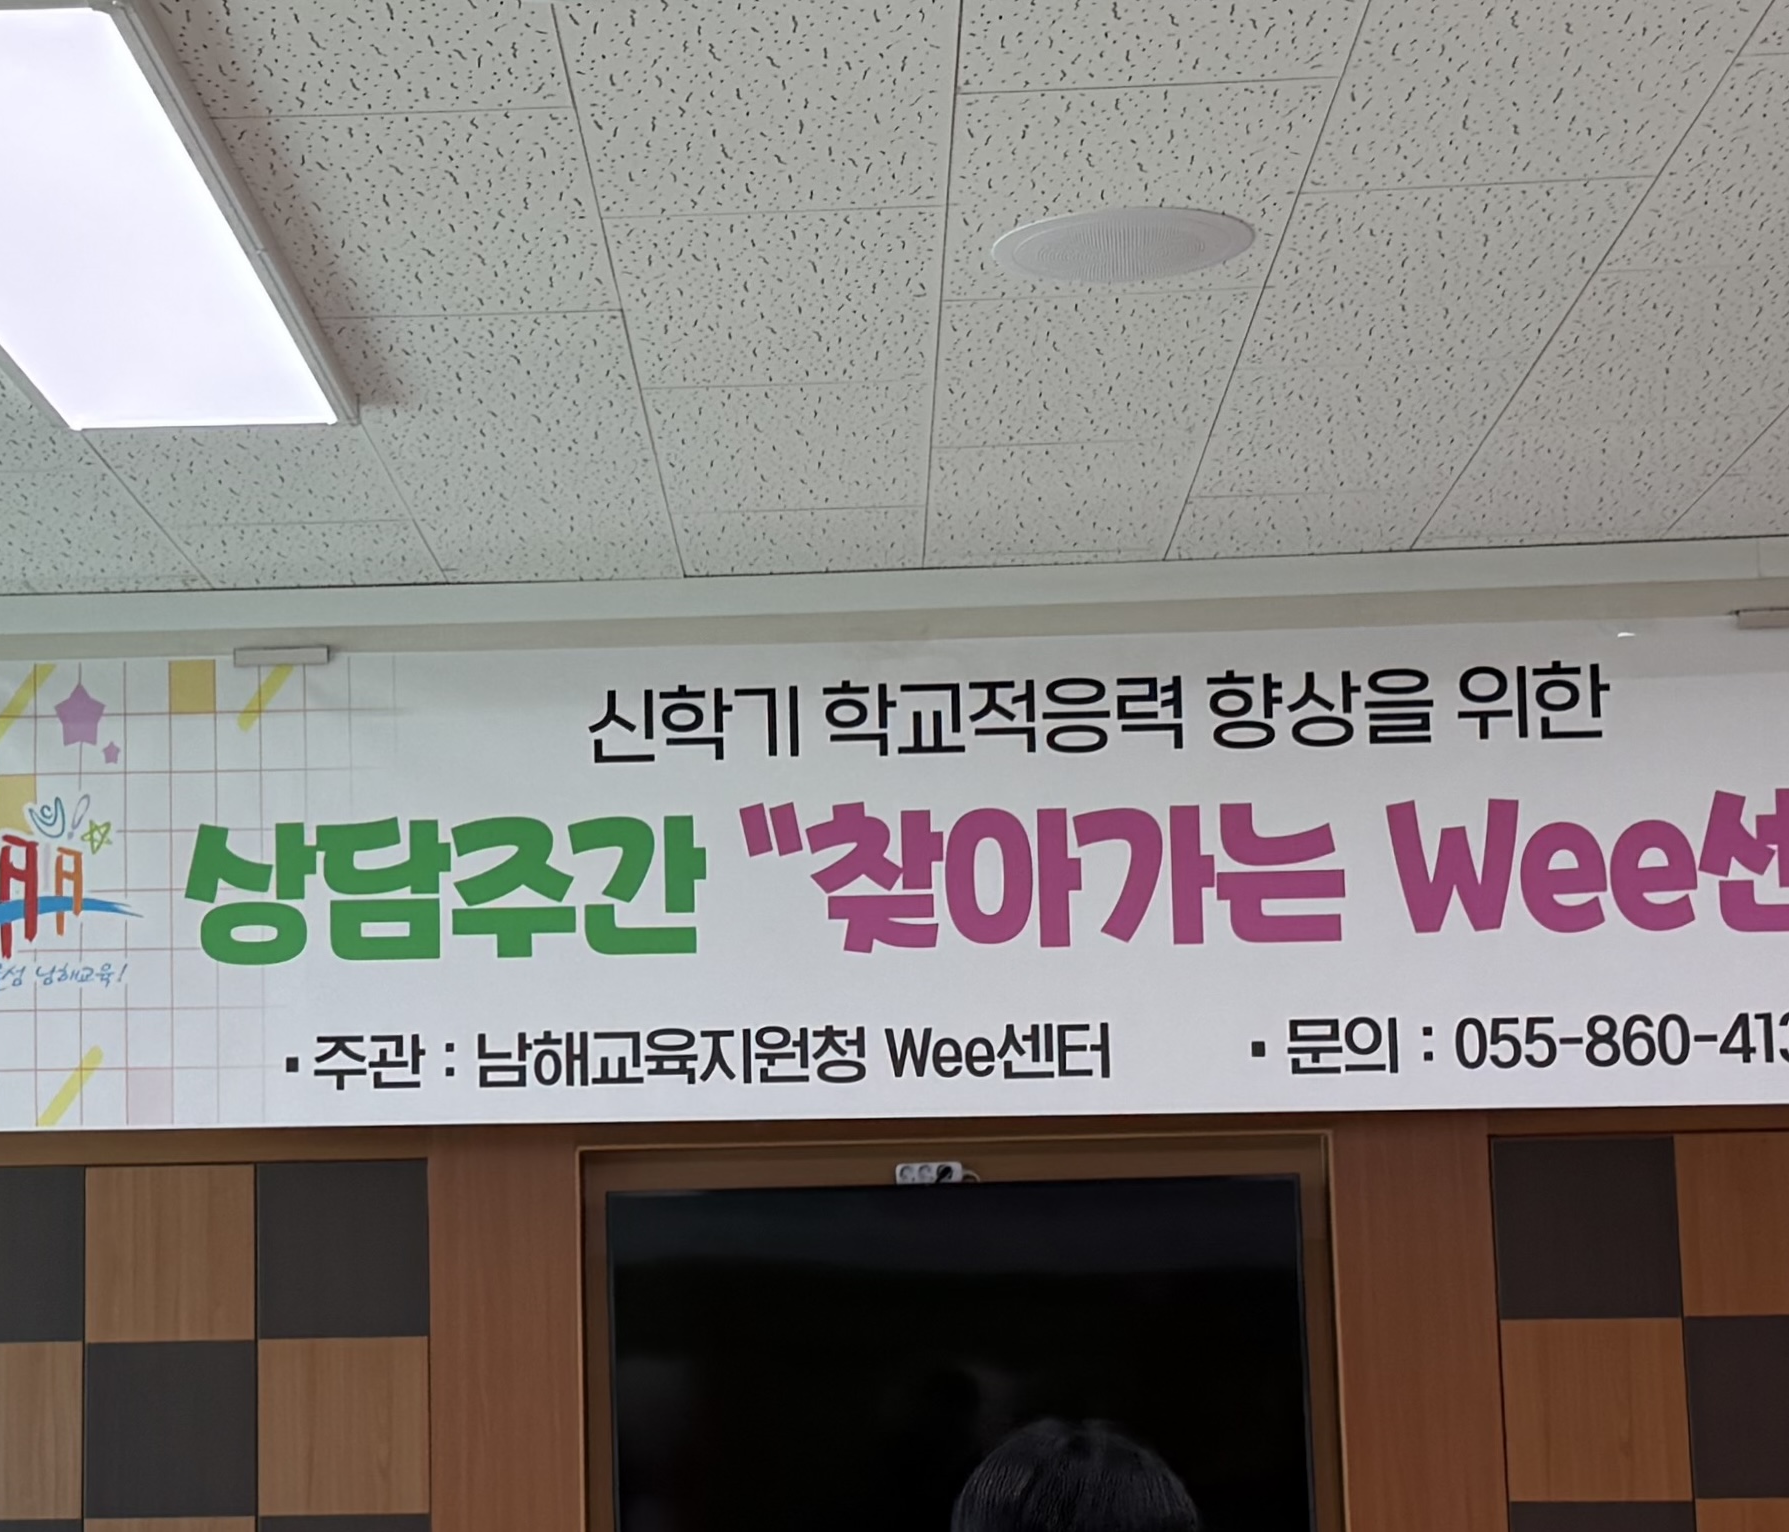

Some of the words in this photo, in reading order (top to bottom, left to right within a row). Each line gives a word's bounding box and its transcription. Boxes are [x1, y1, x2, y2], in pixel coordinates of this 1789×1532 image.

[589, 684, 801, 765] 신학기
[823, 674, 1186, 758] 학교적응력
[1206, 667, 1435, 751] 향상을
[1457, 659, 1612, 743] 위한
[185, 818, 707, 966] 상담주간
[35, 963, 129, 989] 남해교육!
[313, 1033, 427, 1092] 주관
[477, 1025, 868, 1090] 남해교육지원청
[885, 1022, 1112, 1082] Wee센터
[1287, 1016, 1401, 1077] 문의
